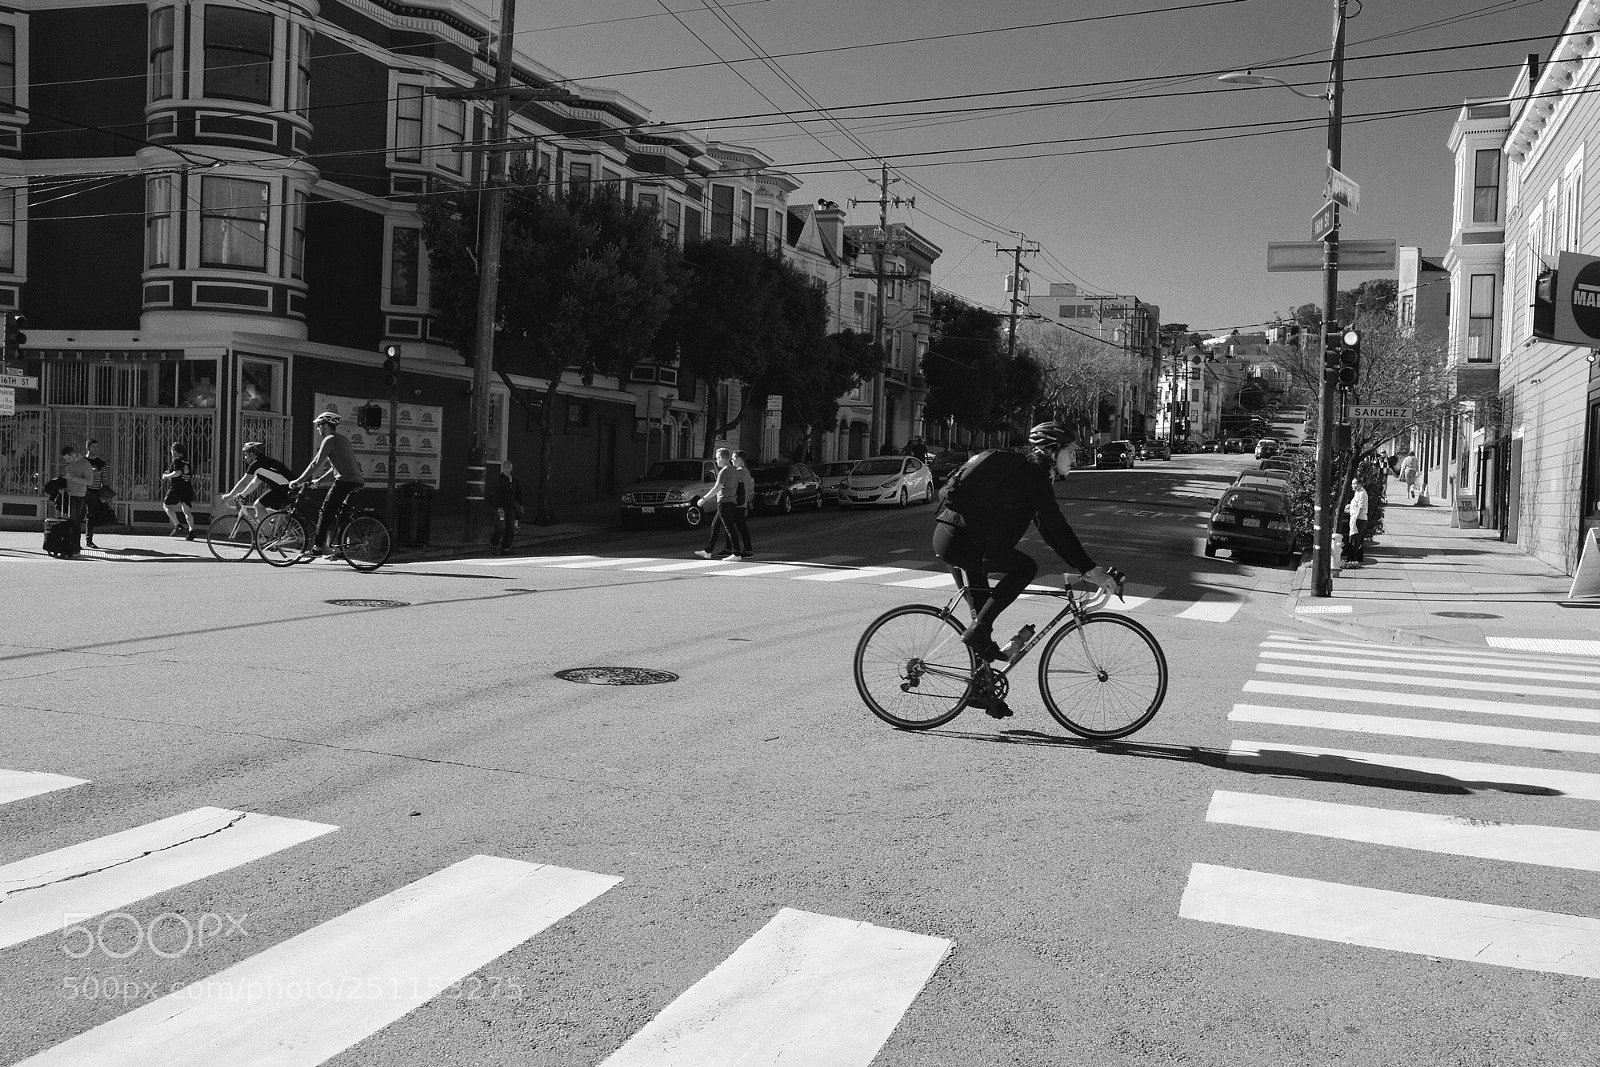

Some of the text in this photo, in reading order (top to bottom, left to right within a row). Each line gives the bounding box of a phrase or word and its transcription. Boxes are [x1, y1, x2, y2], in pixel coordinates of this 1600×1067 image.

[105, 352, 167, 360] EYES
[1, 376, 29, 386] 16TH ST
[1354, 408, 1407, 418] SANCHEZ
